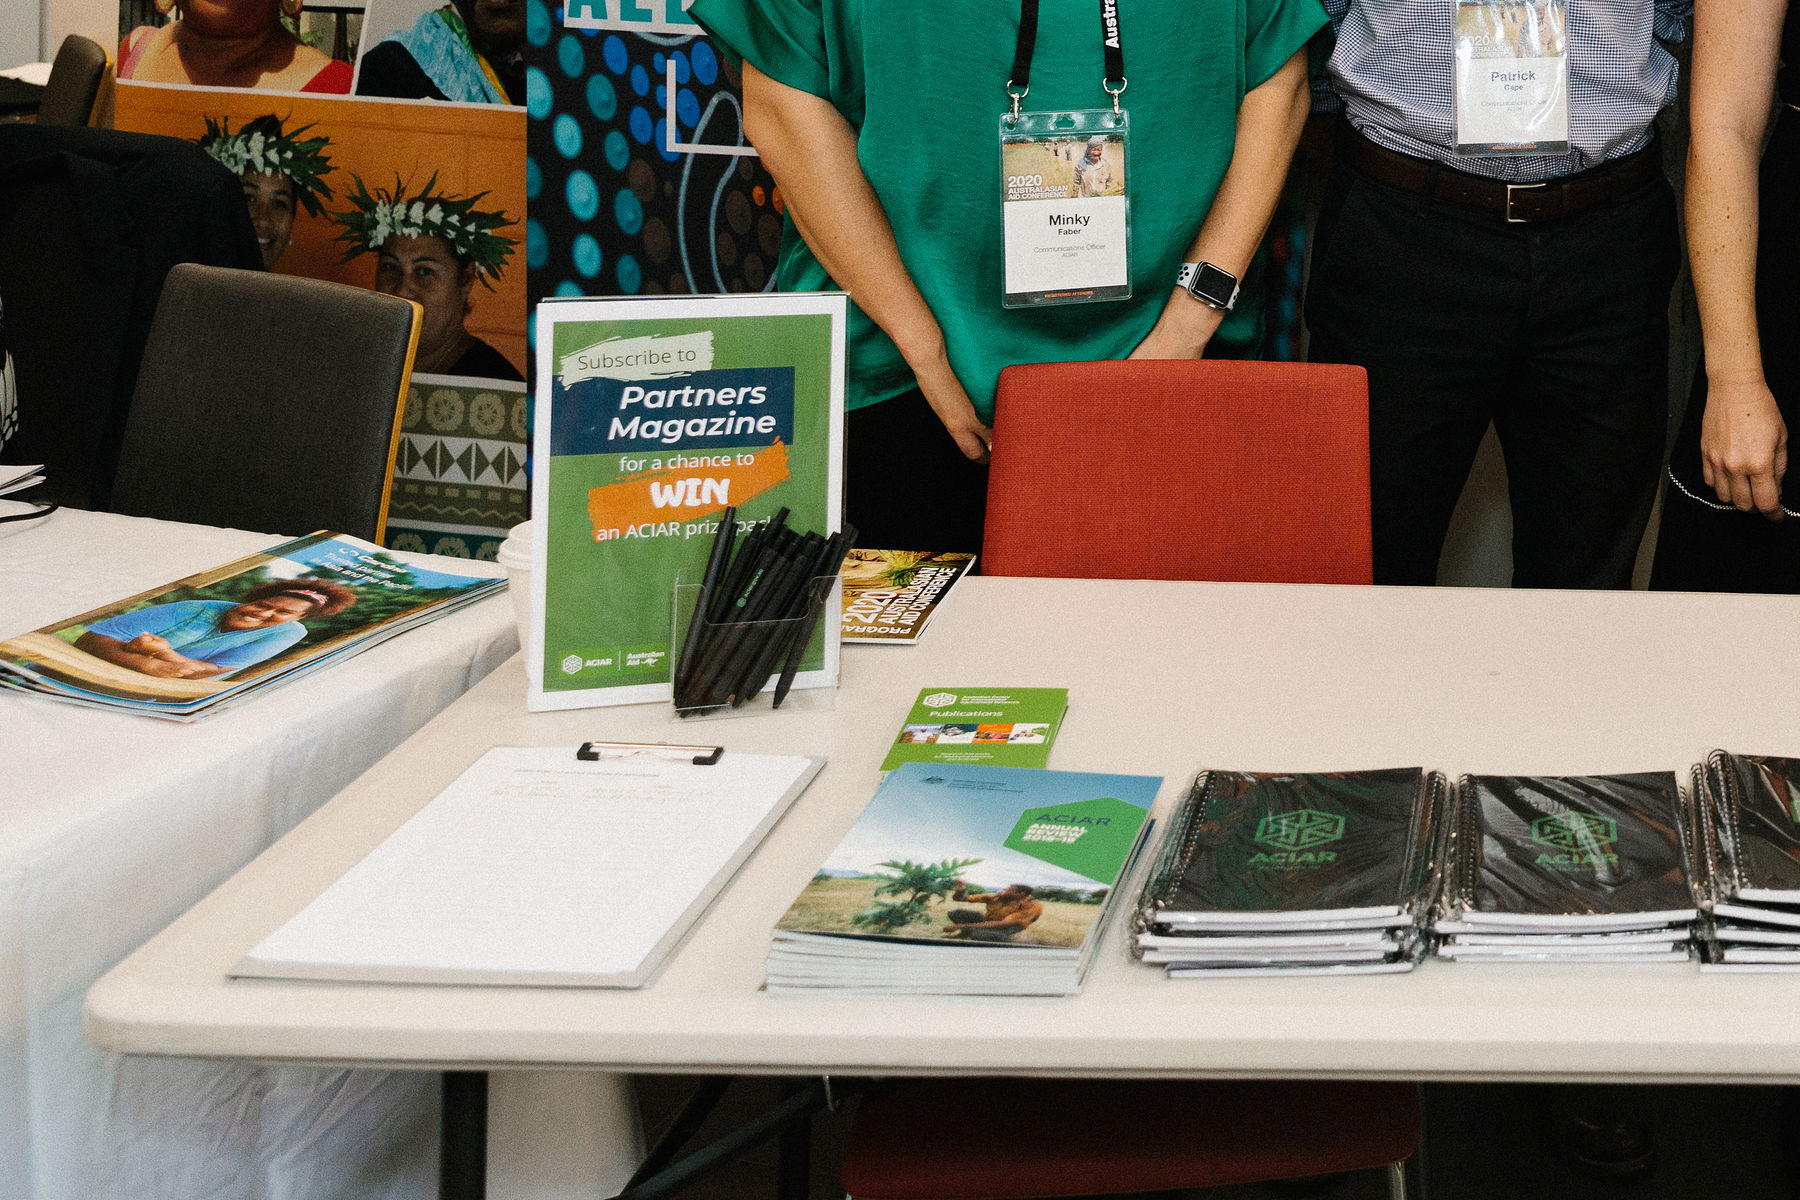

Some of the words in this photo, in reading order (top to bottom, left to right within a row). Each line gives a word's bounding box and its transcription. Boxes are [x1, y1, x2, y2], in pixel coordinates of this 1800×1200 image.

[1491, 71, 1536, 82] Patrick
[1008, 175, 1042, 187] 2020
[1049, 213, 1091, 226] Minky
[578, 349, 671, 371] Subscribe
[678, 348, 696, 363] to
[620, 383, 767, 410] Partners
[607, 411, 776, 443] Magazine
[620, 456, 645, 472] for
[652, 458, 661, 469] a
[668, 453, 731, 470] chance
[736, 452, 754, 466] to
[649, 478, 729, 509] WIN
[597, 528, 620, 541] an
[626, 523, 680, 539] ACIAR
[878, 567, 938, 624] AUSTRALASIAN
[909, 568, 956, 610] CONFERENCE
[842, 591, 896, 623] 2020
[898, 609, 921, 625] AID
[627, 651, 665, 659] Australian
[1035, 814, 1112, 825] ACIAR
[1248, 851, 1337, 863] ACIAR
